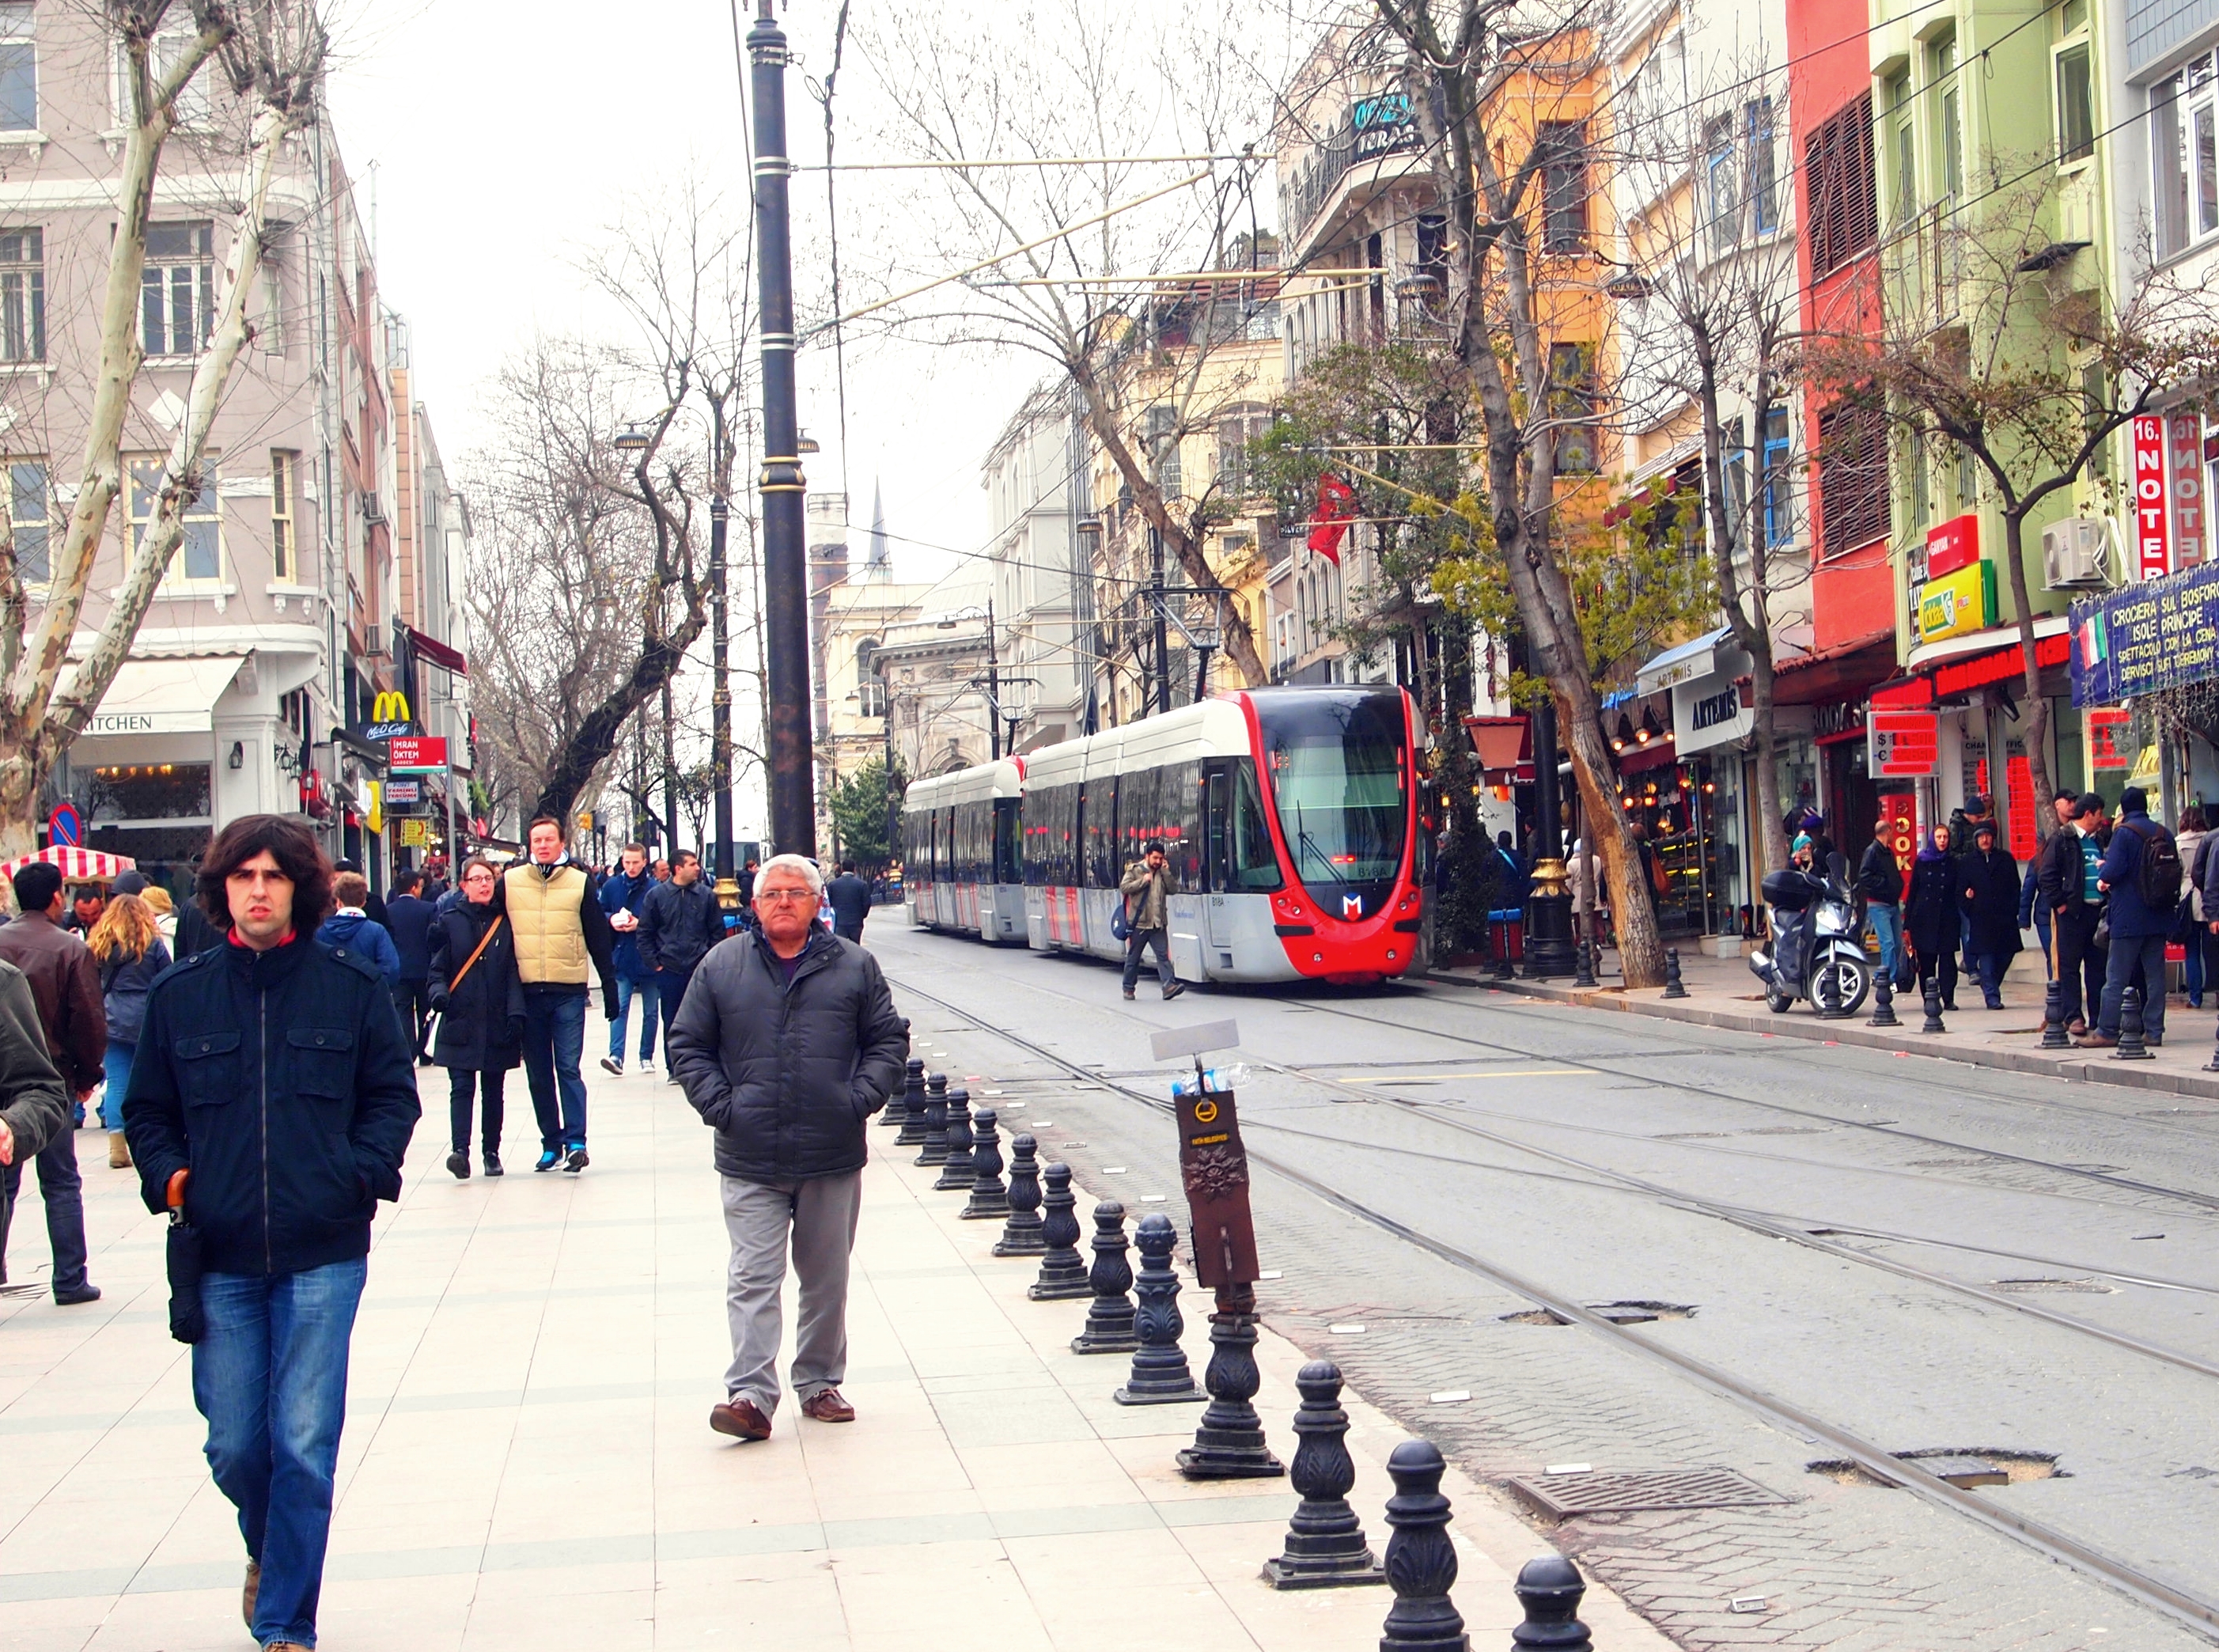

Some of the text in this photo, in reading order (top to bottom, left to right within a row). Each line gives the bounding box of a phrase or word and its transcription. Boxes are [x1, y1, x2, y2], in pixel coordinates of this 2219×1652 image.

[2135, 420, 2160, 441] 16.
[2112, 600, 2157, 627] CROCIERA
[2161, 597, 2176, 613] SUL
[2133, 607, 2203, 642] ISOLE PRINCIPE
[2118, 627, 2217, 664] SPETTACOLO CON LA CENA
[2121, 661, 2154, 682] DERVISCI
[1692, 684, 1737, 731] ARTEMİS
[393, 740, 418, 749] İMRAN
[1878, 733, 1887, 746] $
[393, 750, 419, 760] ÖKTEM
